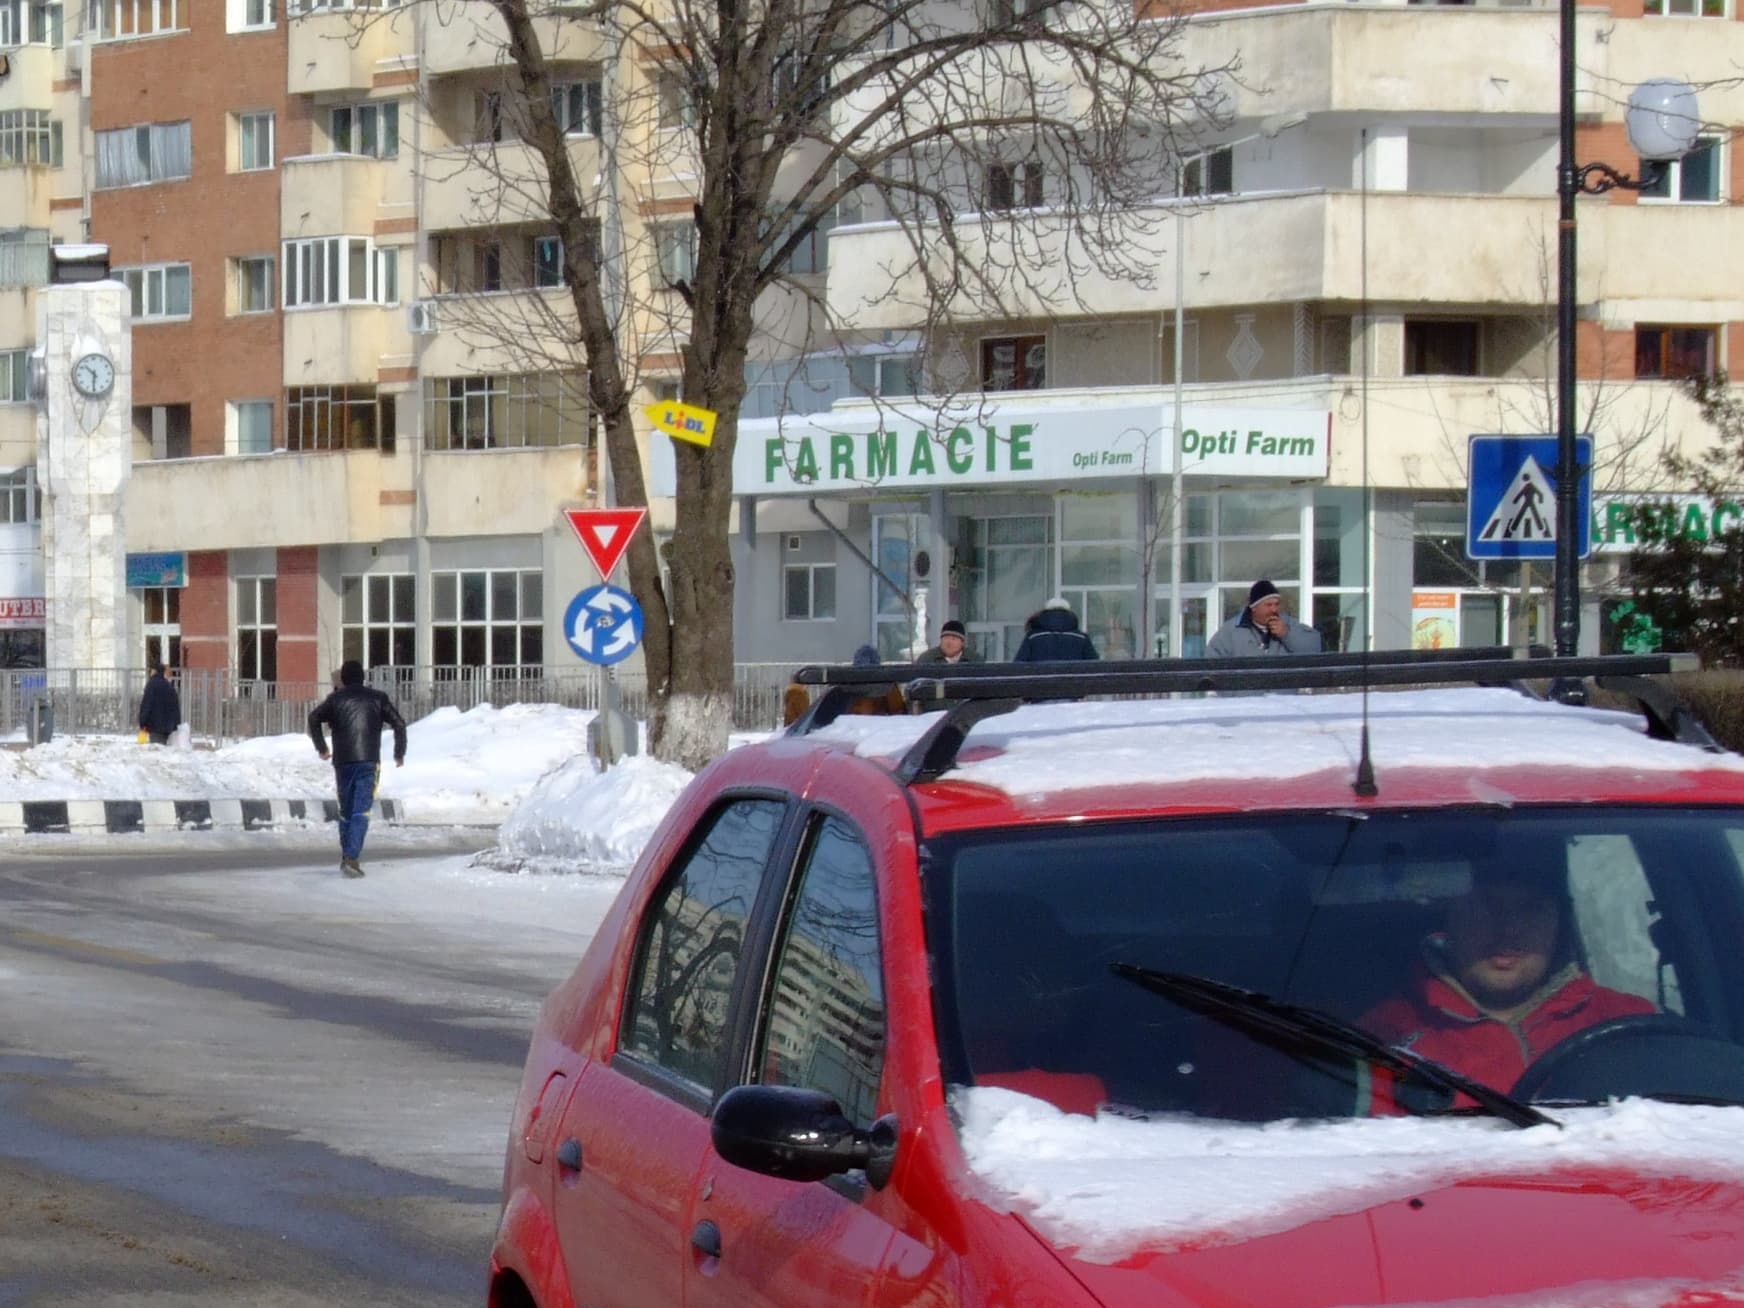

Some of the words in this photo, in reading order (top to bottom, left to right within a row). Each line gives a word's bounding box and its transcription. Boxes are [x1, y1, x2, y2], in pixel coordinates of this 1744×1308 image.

[765, 424, 1034, 483] FARMACIE
[1072, 450, 1098, 470] Opti
[1101, 450, 1133, 465] Farm
[1181, 428, 1238, 460] Opti
[1245, 430, 1315, 457] Farm
